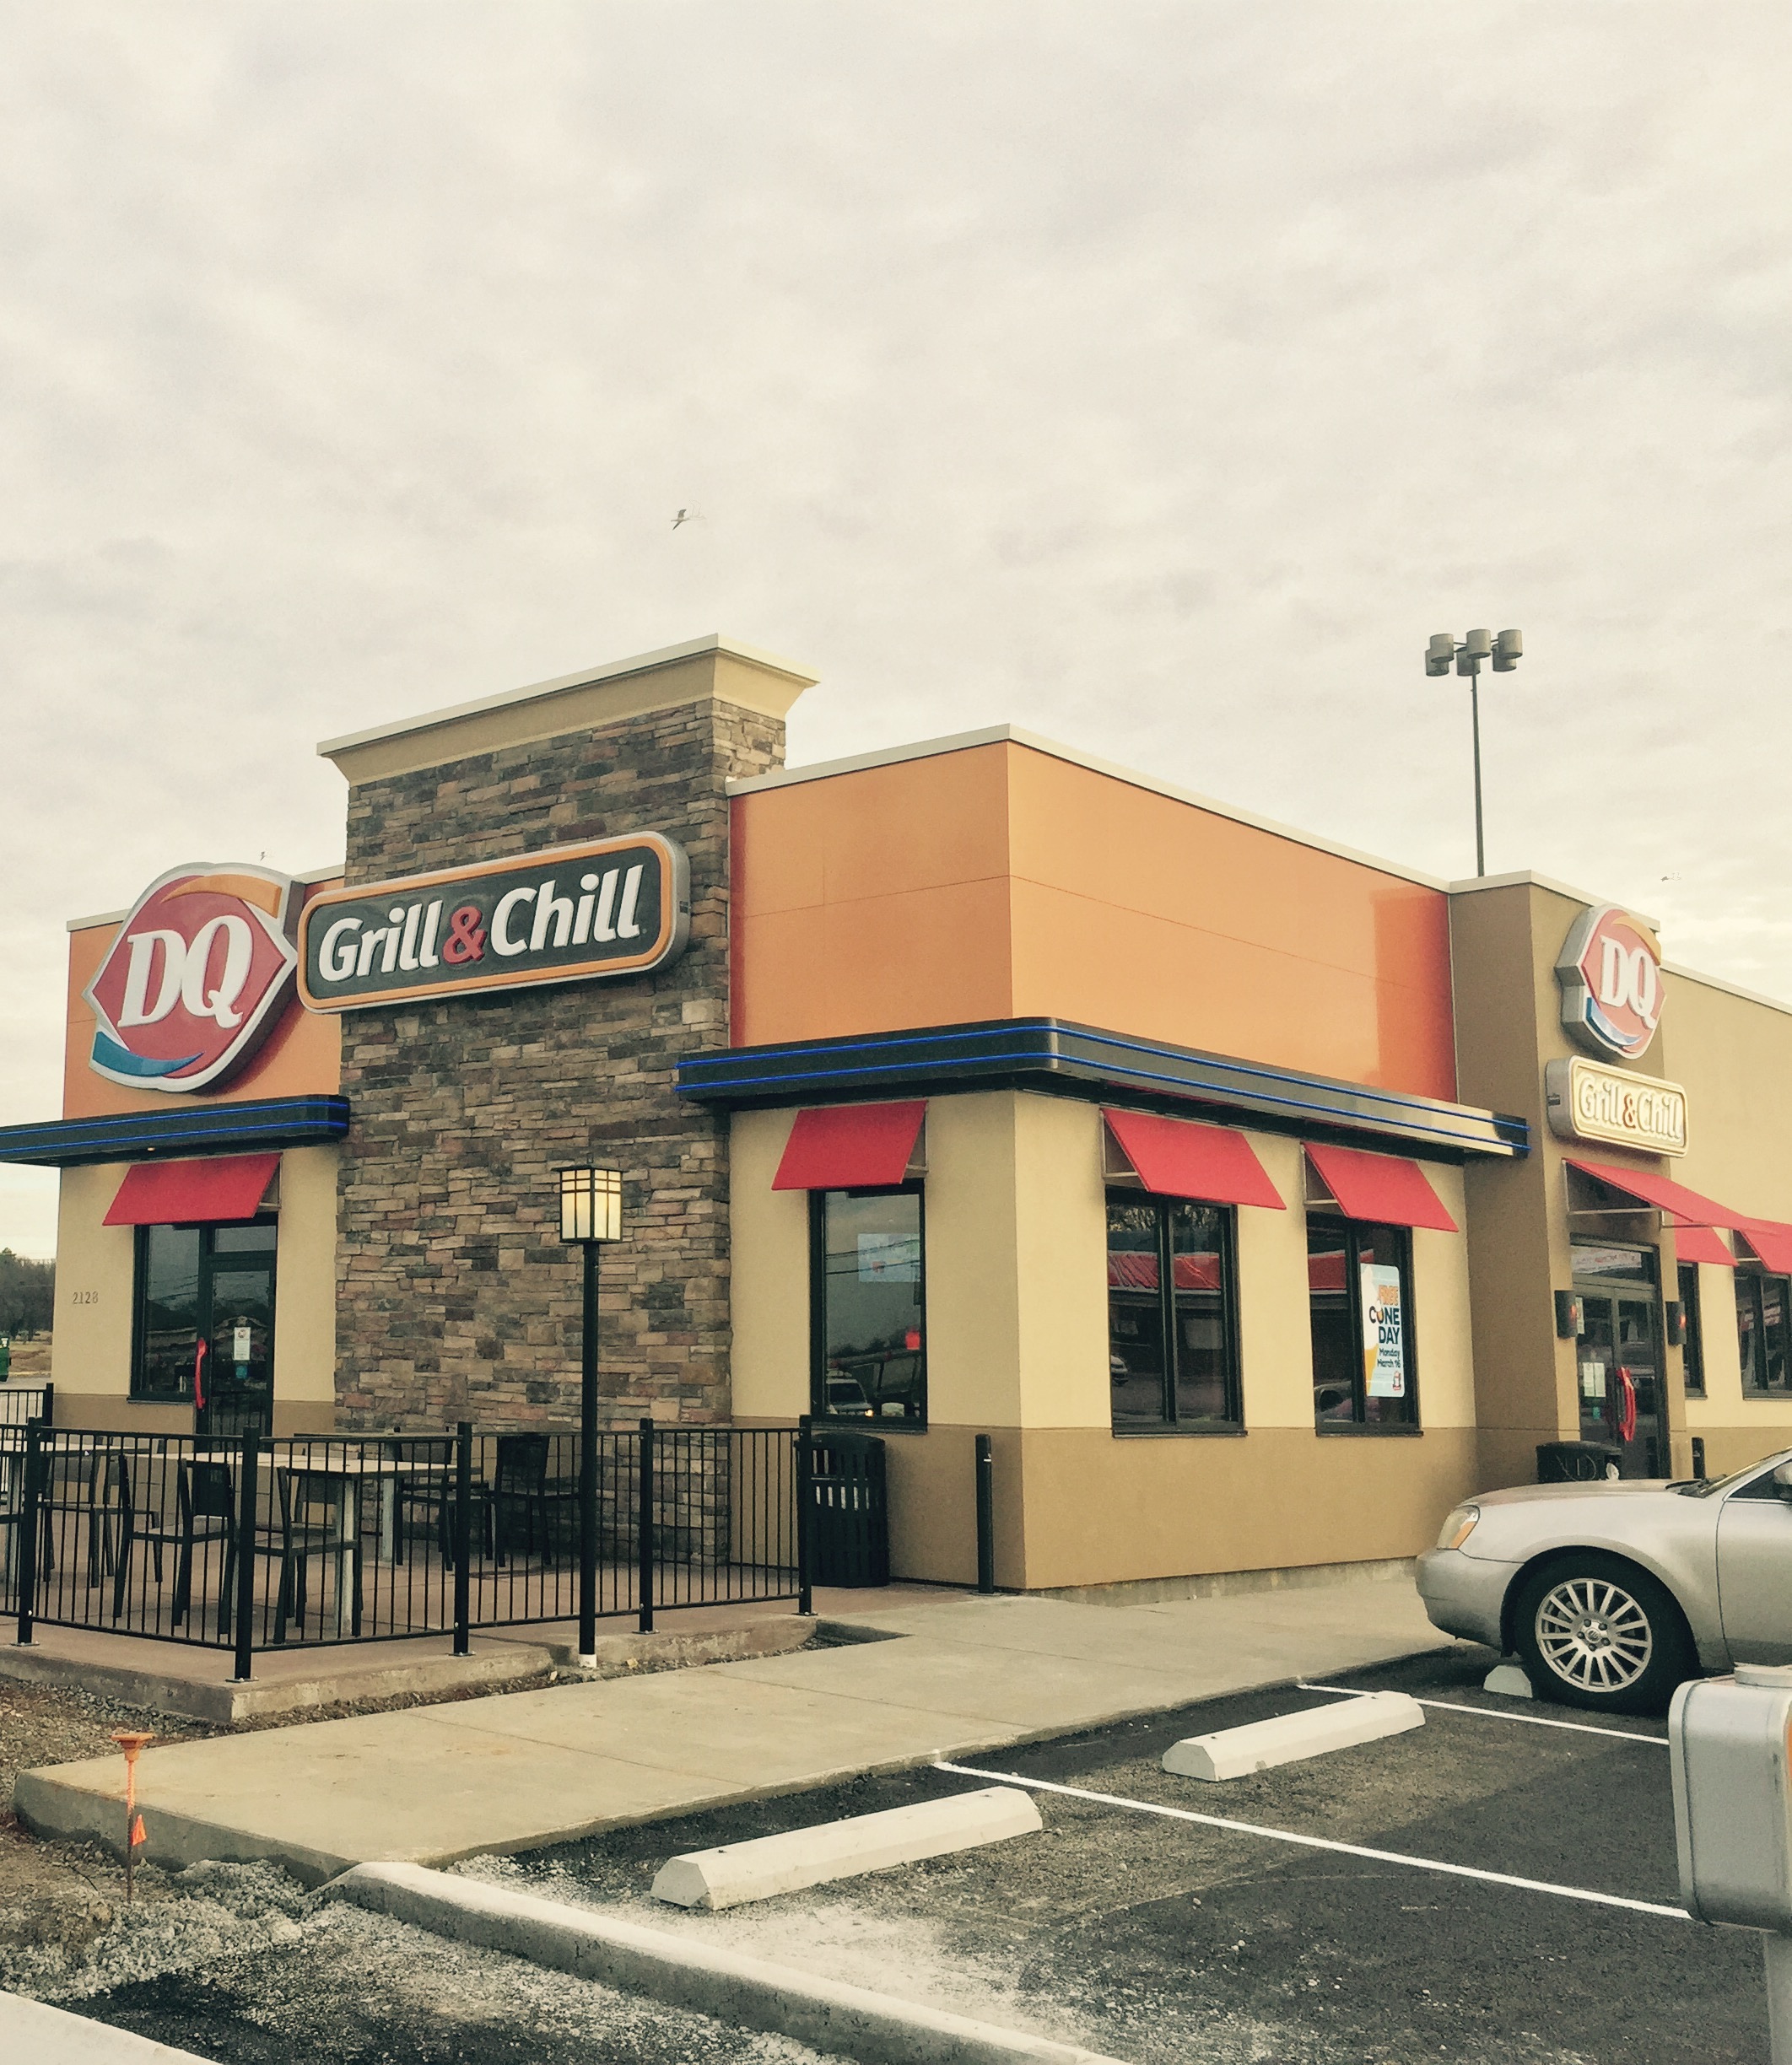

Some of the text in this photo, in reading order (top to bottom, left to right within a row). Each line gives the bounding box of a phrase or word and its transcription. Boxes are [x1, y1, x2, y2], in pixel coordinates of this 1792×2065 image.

[116, 914, 253, 1029] DQ
[1600, 935, 1656, 1029] DQ
[73, 1291, 99, 1304] 2128
[1369, 1306, 1400, 1326] CONE
[1379, 1325, 1400, 1345] DAY
[1377, 1358, 1394, 1367] March
[1379, 1348, 1401, 1359] Monday
